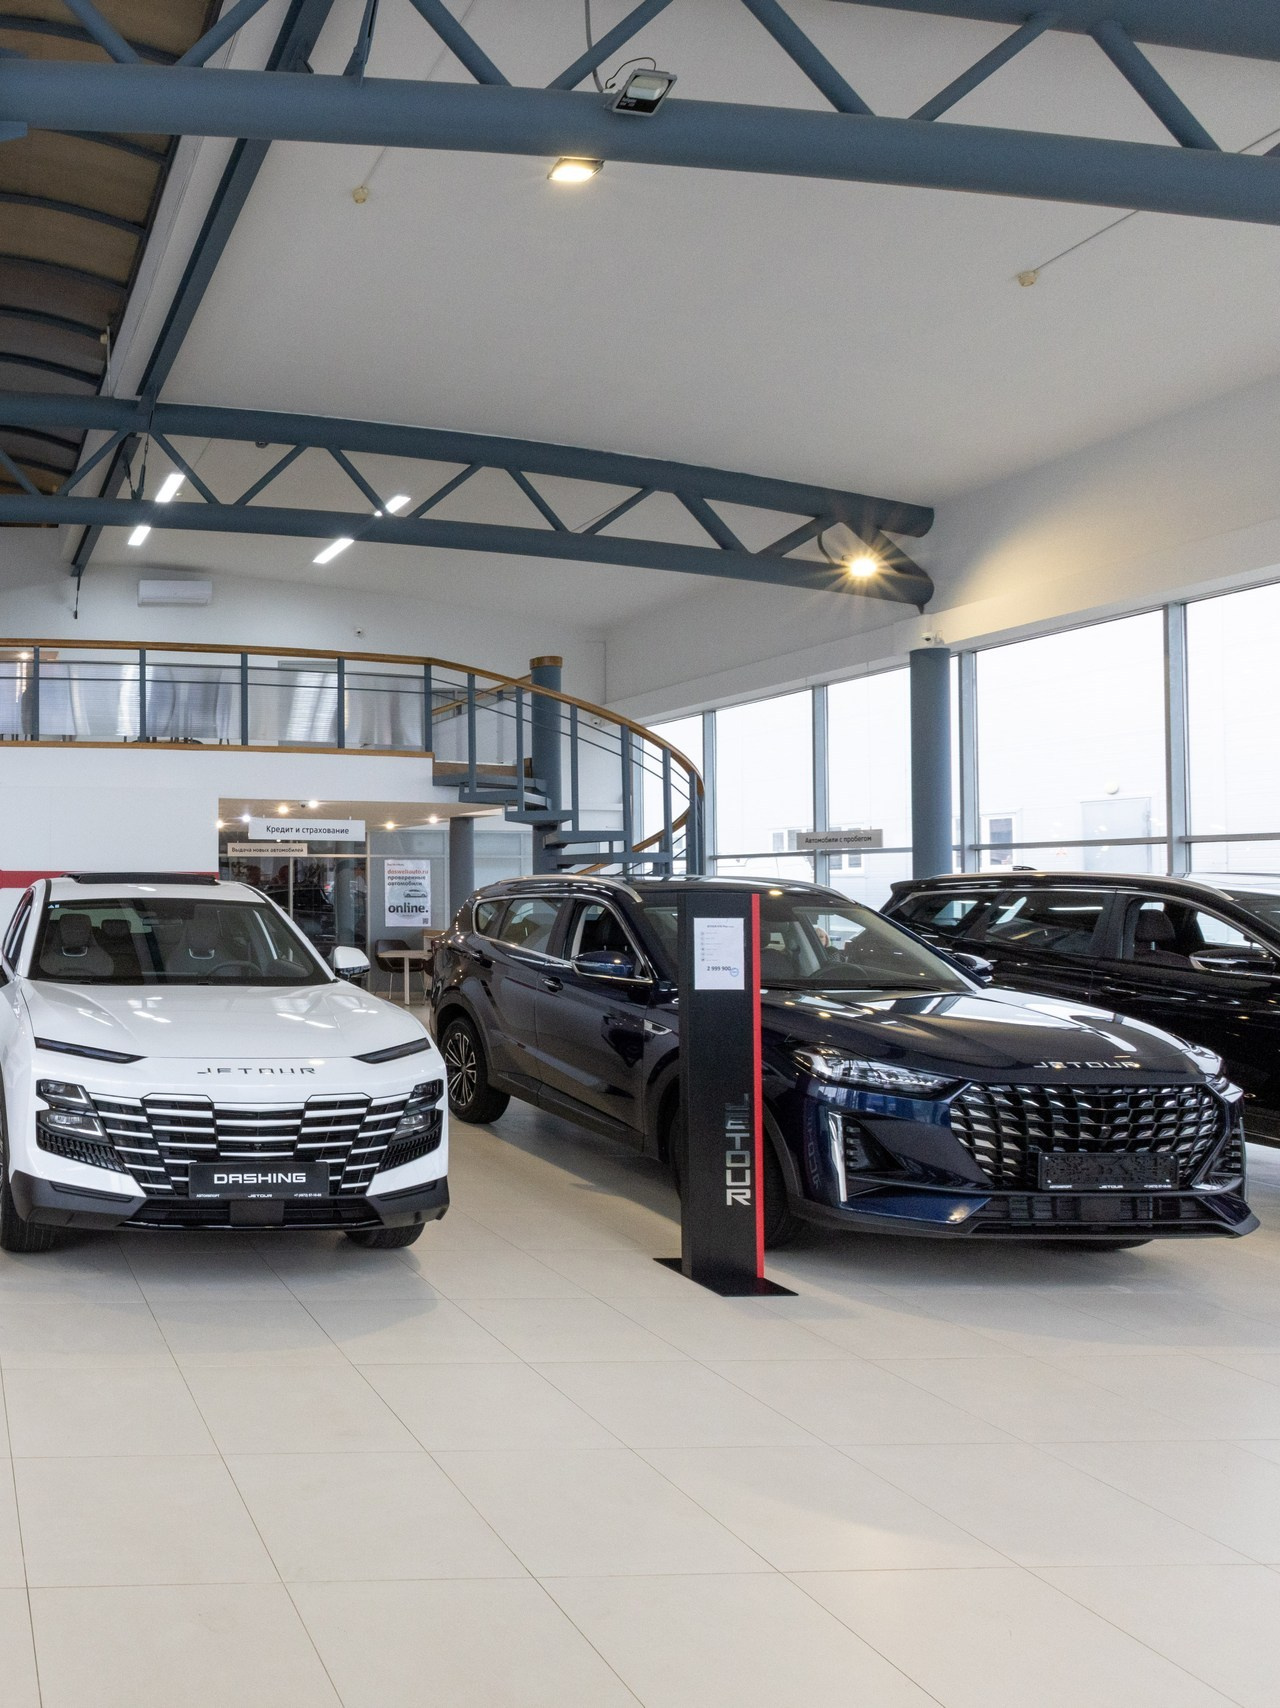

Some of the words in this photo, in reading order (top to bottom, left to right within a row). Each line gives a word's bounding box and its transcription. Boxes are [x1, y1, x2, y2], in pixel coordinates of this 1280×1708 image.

[266, 825, 294, 834] Кредит
[301, 827, 350, 835] страхование
[805, 836, 838, 844] Автомобили
[843, 835, 872, 844] пробегом
[388, 902, 429, 913] online.
[197, 1062, 316, 1075] JETOUR
[1033, 1061, 1141, 1069] JETOUR
[725, 1093, 751, 1206] JETOUR
[213, 1172, 307, 1185] DASHING
